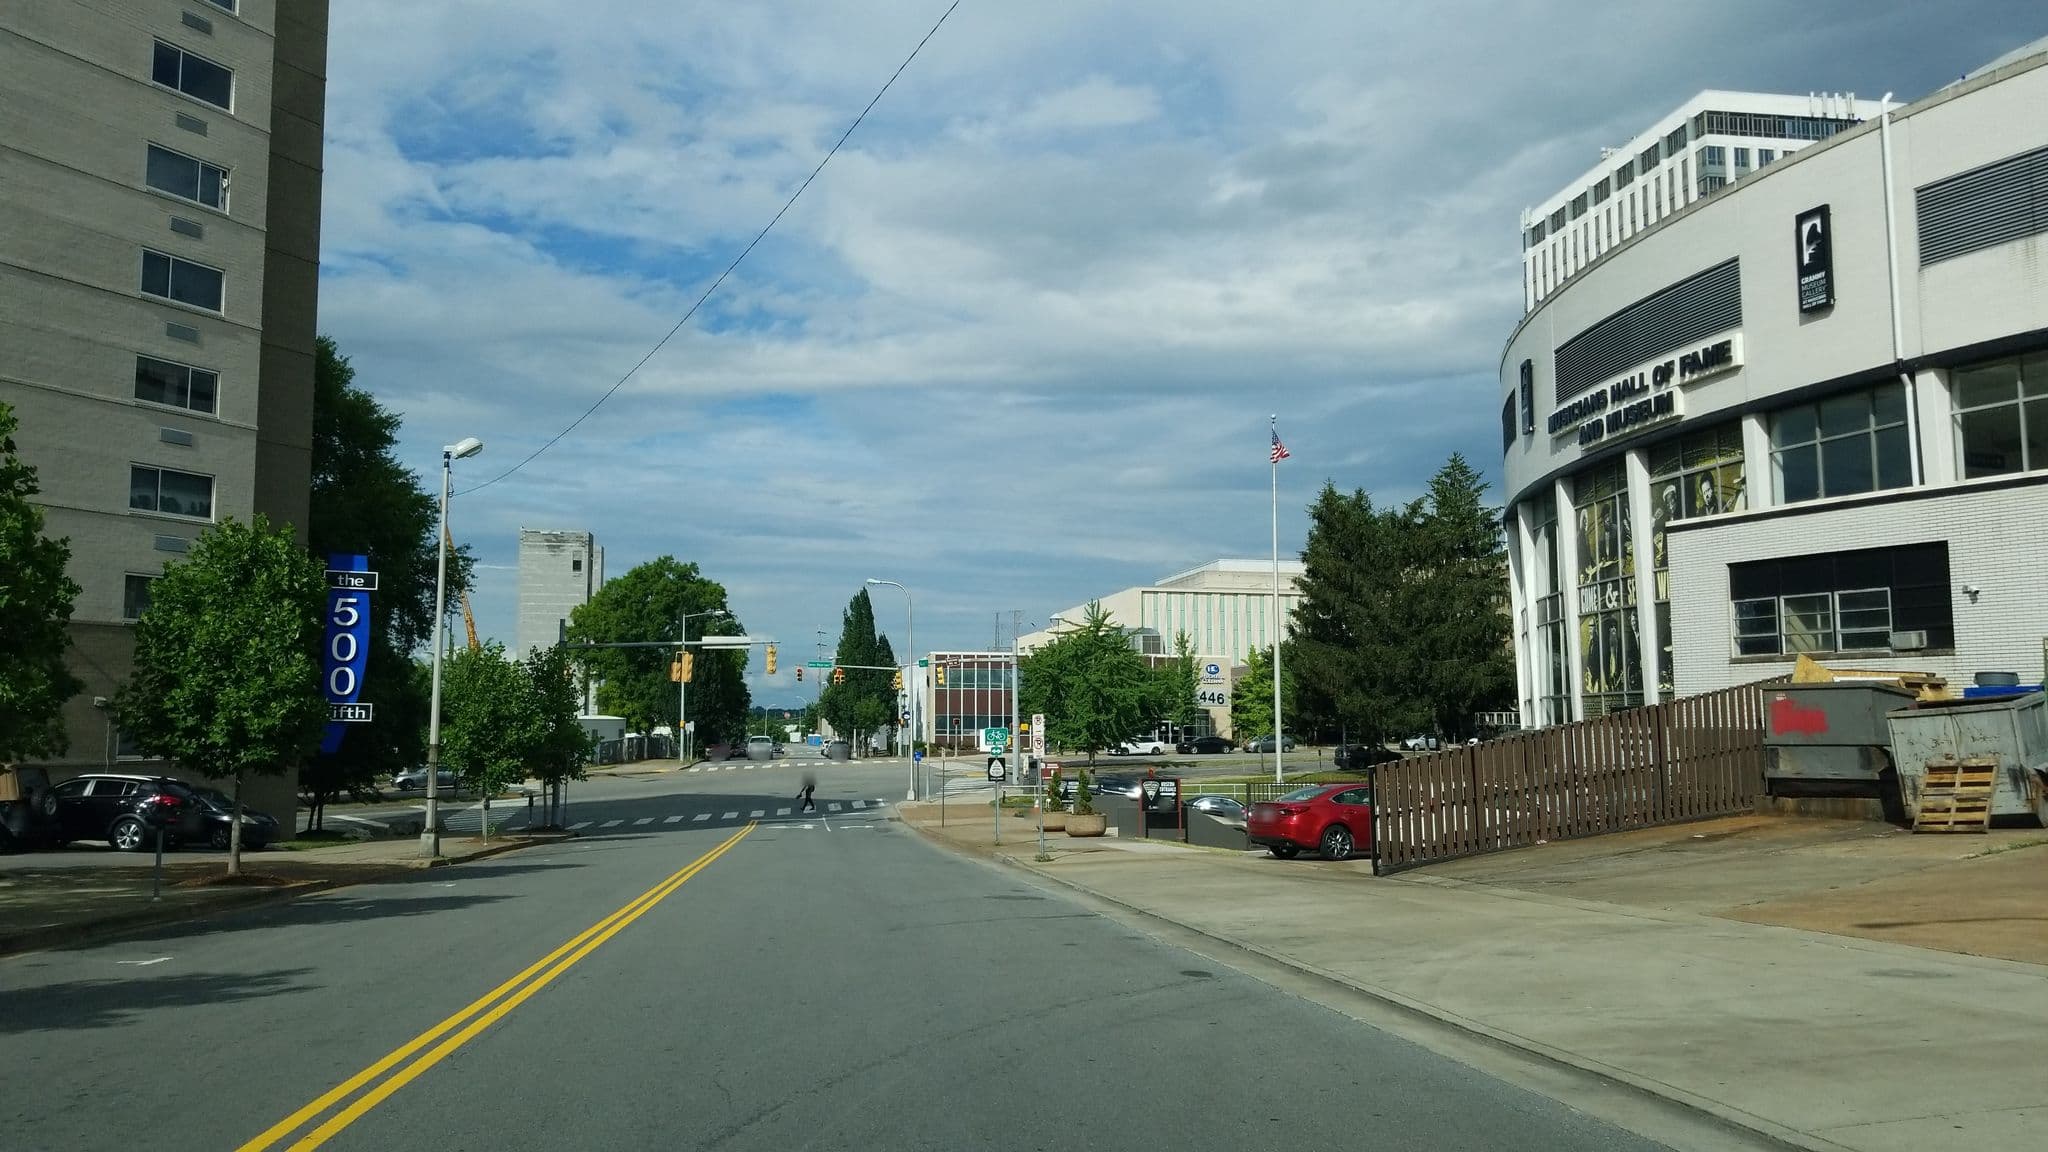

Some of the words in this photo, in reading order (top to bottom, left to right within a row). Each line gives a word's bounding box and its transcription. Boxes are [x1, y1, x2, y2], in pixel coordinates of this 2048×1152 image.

[1801, 271, 1826, 284] GRAMMY
[1548, 389, 1608, 434] MUSICIANS
[1610, 372, 1649, 404] HALL
[1652, 360, 1675, 387] OF
[1679, 339, 1732, 376] FAME
[1579, 418, 1604, 446] AND
[1606, 391, 1675, 434] MUSEUM
[338, 573, 365, 587] the
[1580, 585, 1598, 613] COME
[1605, 582, 1618, 609] &
[1200, 690, 1225, 705] 446
[331, 705, 366, 719] ifth
